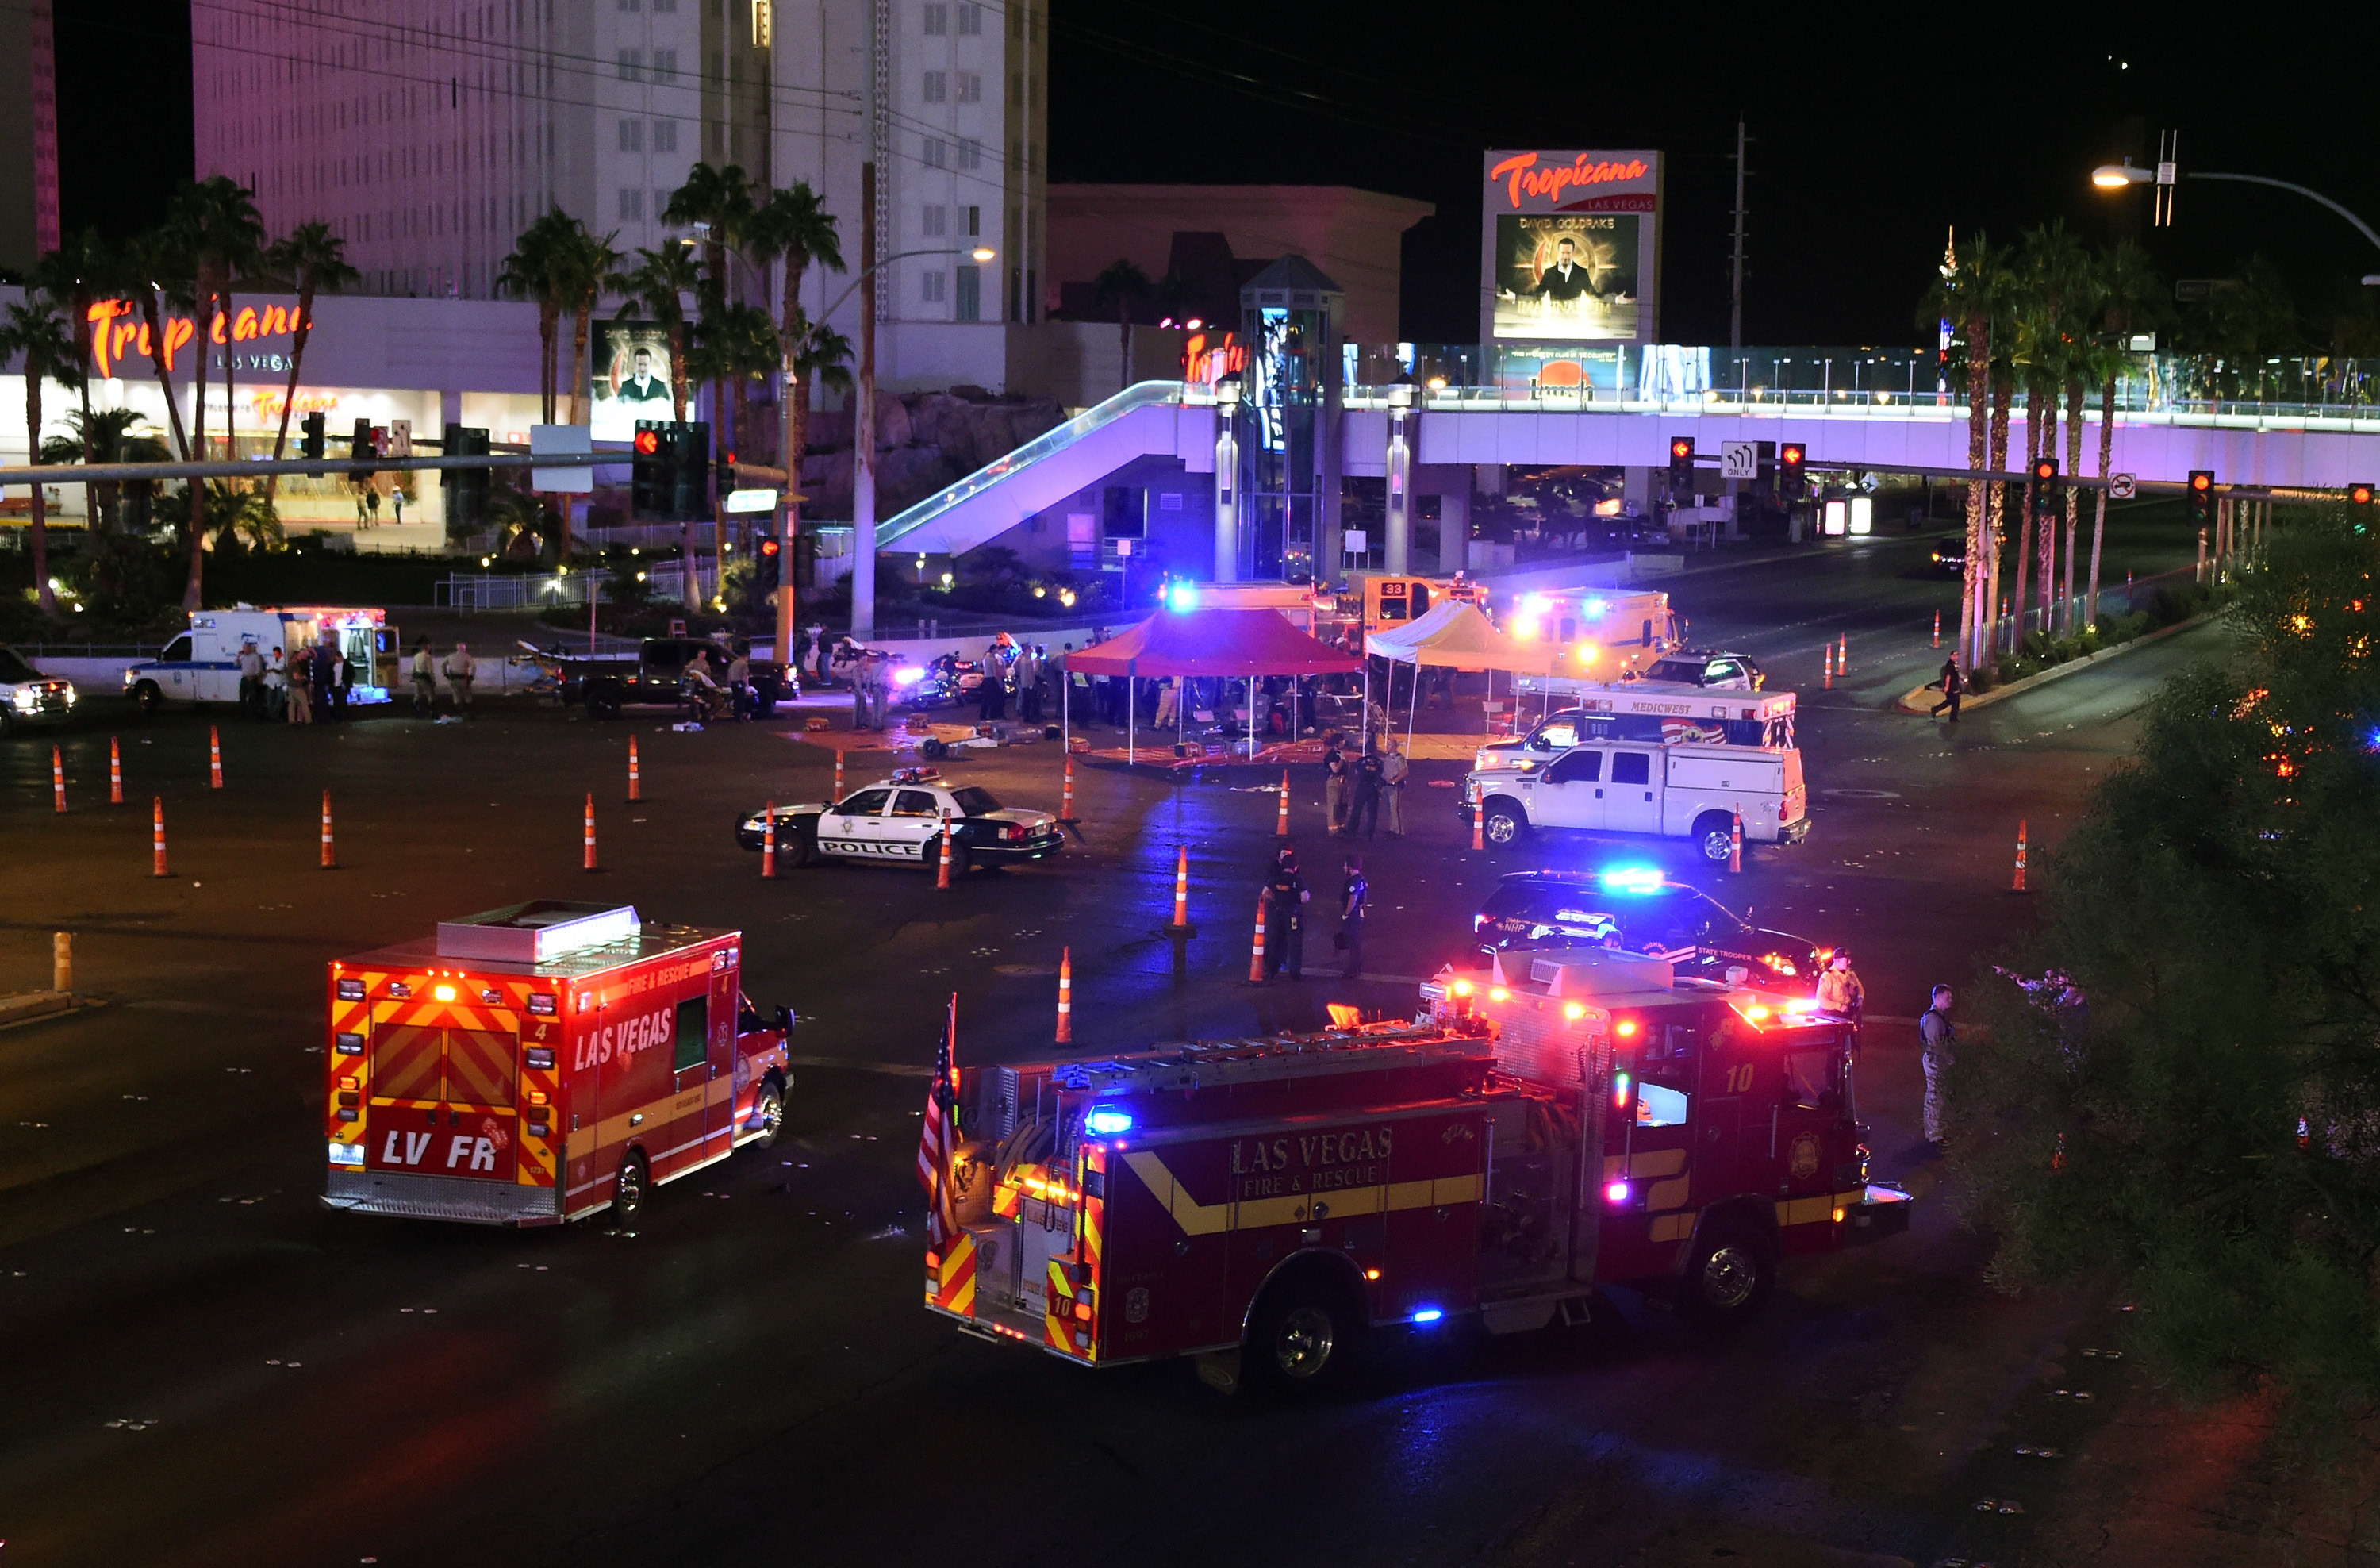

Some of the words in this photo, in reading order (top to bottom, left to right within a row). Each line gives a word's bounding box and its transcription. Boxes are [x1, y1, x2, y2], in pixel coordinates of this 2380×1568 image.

[1491, 152, 1648, 209] Tropicana
[1588, 200, 1609, 209] LAS
[1613, 200, 1653, 210] VEGAS
[1519, 218, 1553, 229] DAVID
[1557, 217, 1614, 229] GOLDRAKE
[1386, 584, 1402, 594] 33
[1631, 701, 1691, 715] MEDICWEST
[823, 842, 919, 856] POLICE
[1698, 947, 1718, 957] STATE
[1720, 950, 1752, 961] TROOPER
[628, 974, 647, 994] FIRE
[649, 974, 655, 990] &
[658, 963, 690, 986] RESCUE
[535, 1023, 547, 1040] 4
[574, 1026, 613, 1071] LAS
[616, 1007, 672, 1058] VEGAS
[1726, 1062, 1754, 1093] 10
[382, 1130, 432, 1165] LV
[447, 1135, 497, 1171] FR
[1231, 1139, 1288, 1174] LAS
[1299, 1126, 1393, 1167] VEGAS
[1244, 1177, 1284, 1197] FIRE
[1292, 1174, 1302, 1191] &
[1312, 1166, 1377, 1189] RESCUE
[1054, 1296, 1070, 1317] 10
